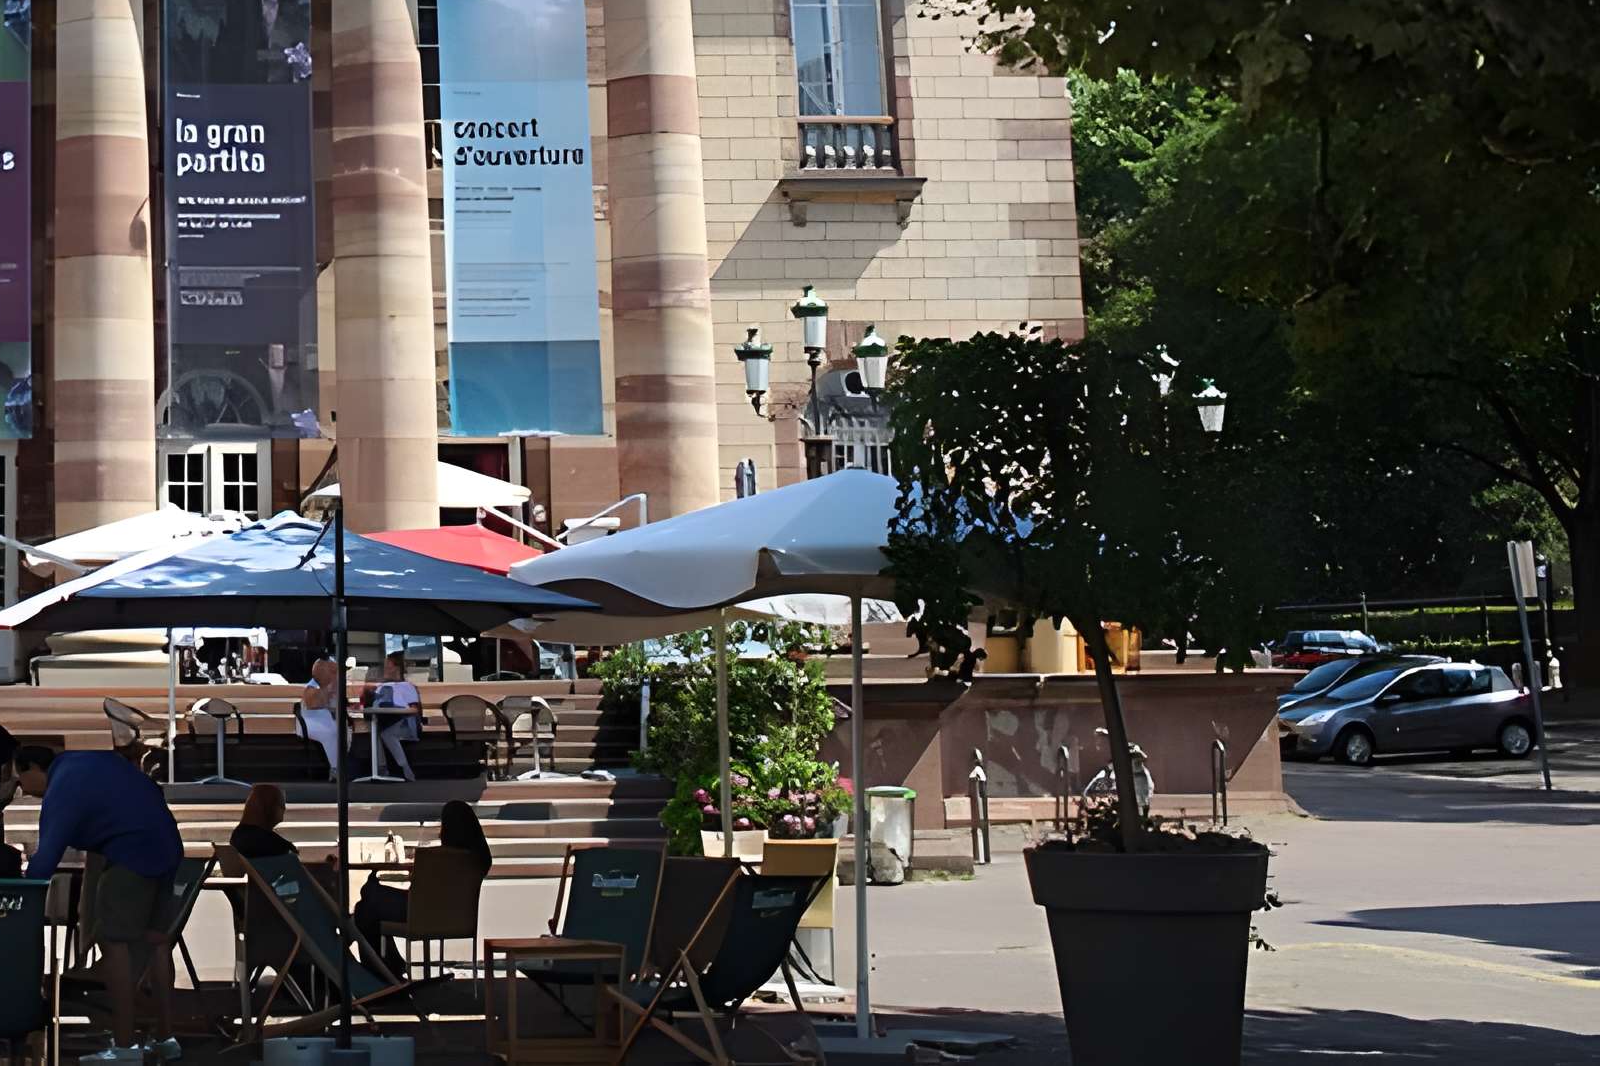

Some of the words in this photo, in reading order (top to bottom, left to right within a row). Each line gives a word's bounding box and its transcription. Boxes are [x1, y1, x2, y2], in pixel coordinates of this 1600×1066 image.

[176, 117, 198, 143] la
[207, 124, 265, 149] gran
[453, 118, 539, 139] concert
